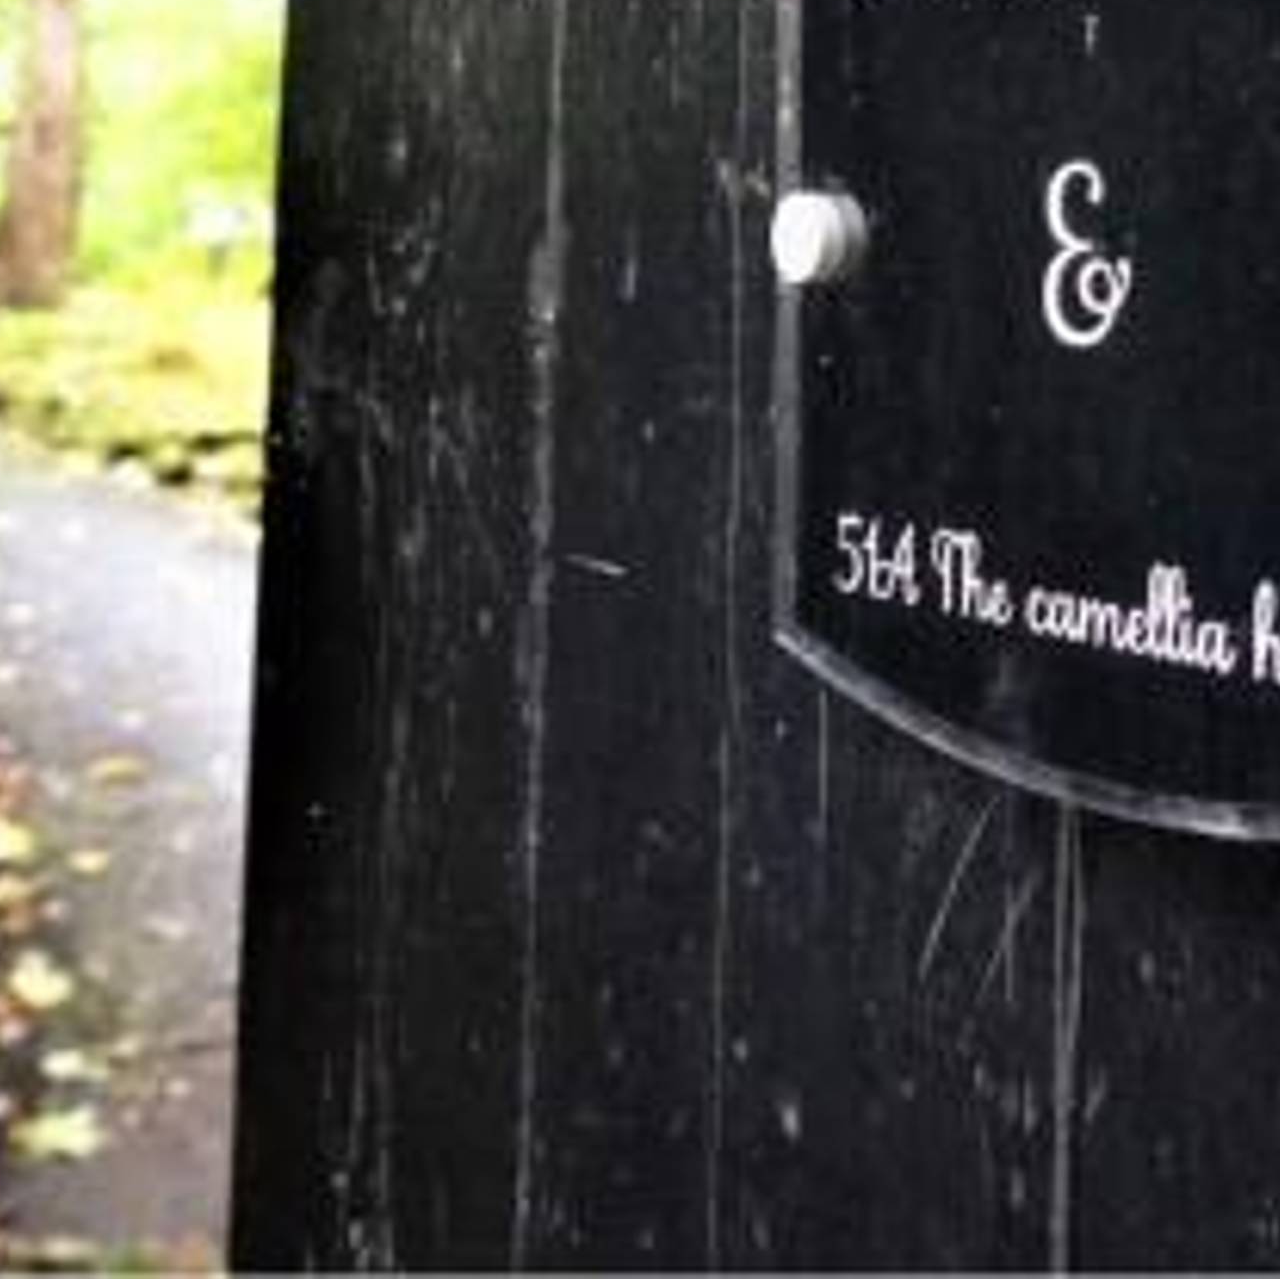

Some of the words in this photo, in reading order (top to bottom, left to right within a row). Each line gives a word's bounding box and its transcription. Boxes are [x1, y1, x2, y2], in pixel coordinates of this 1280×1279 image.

[1042, 159, 1132, 347] &
[930, 528, 1014, 625] The
[1024, 562, 1238, 674] camellia
